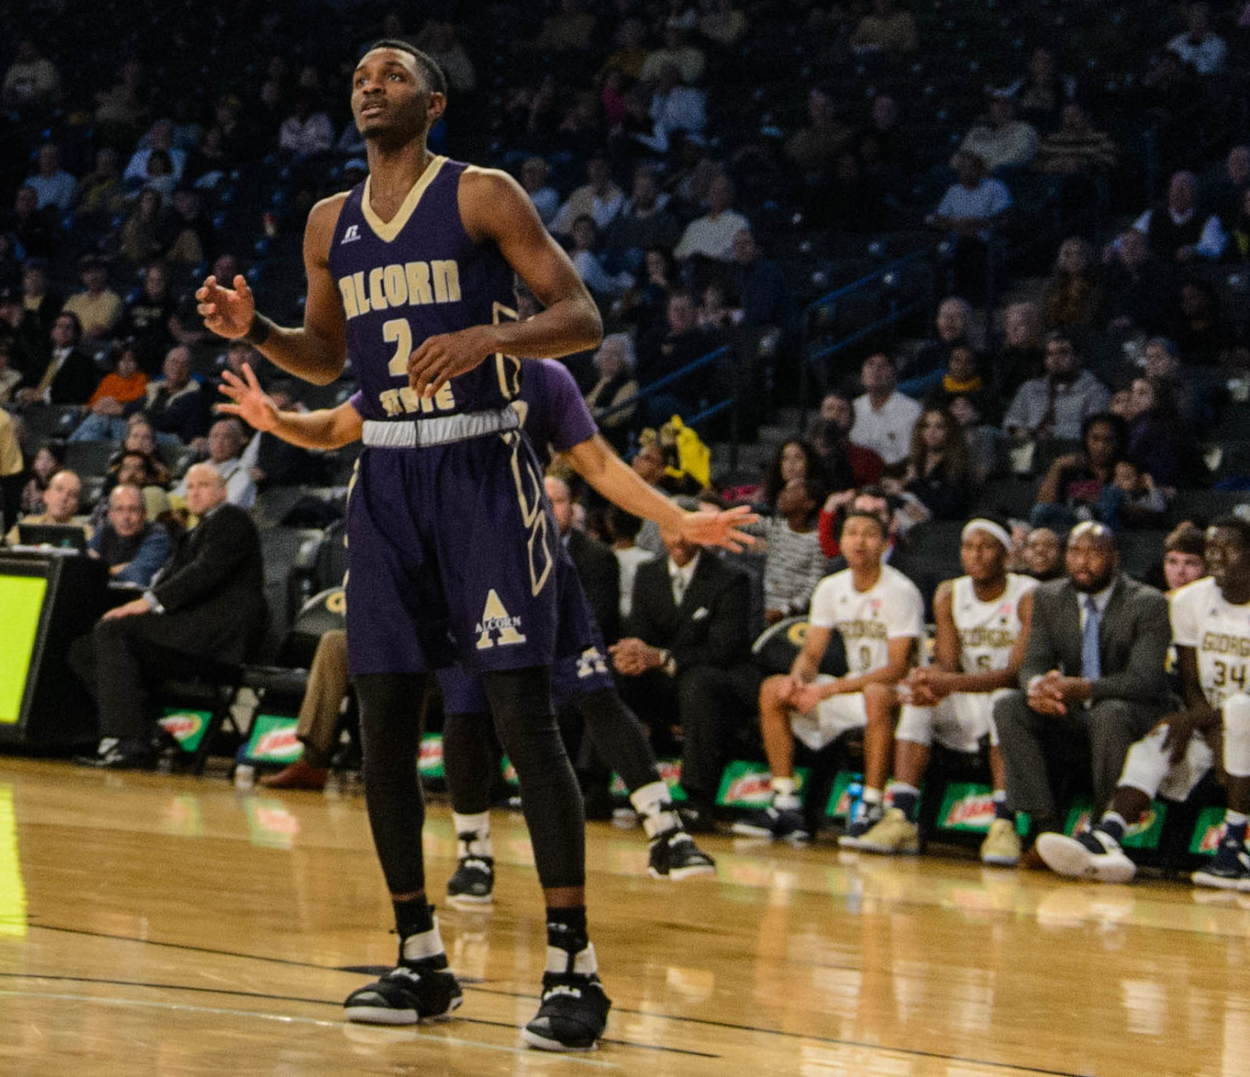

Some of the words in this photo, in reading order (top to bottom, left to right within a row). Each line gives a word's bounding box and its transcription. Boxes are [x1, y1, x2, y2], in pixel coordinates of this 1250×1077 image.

[338, 259, 462, 321] ALCORN
[382, 317, 413, 378] 2
[1213, 659, 1246, 690] 34
